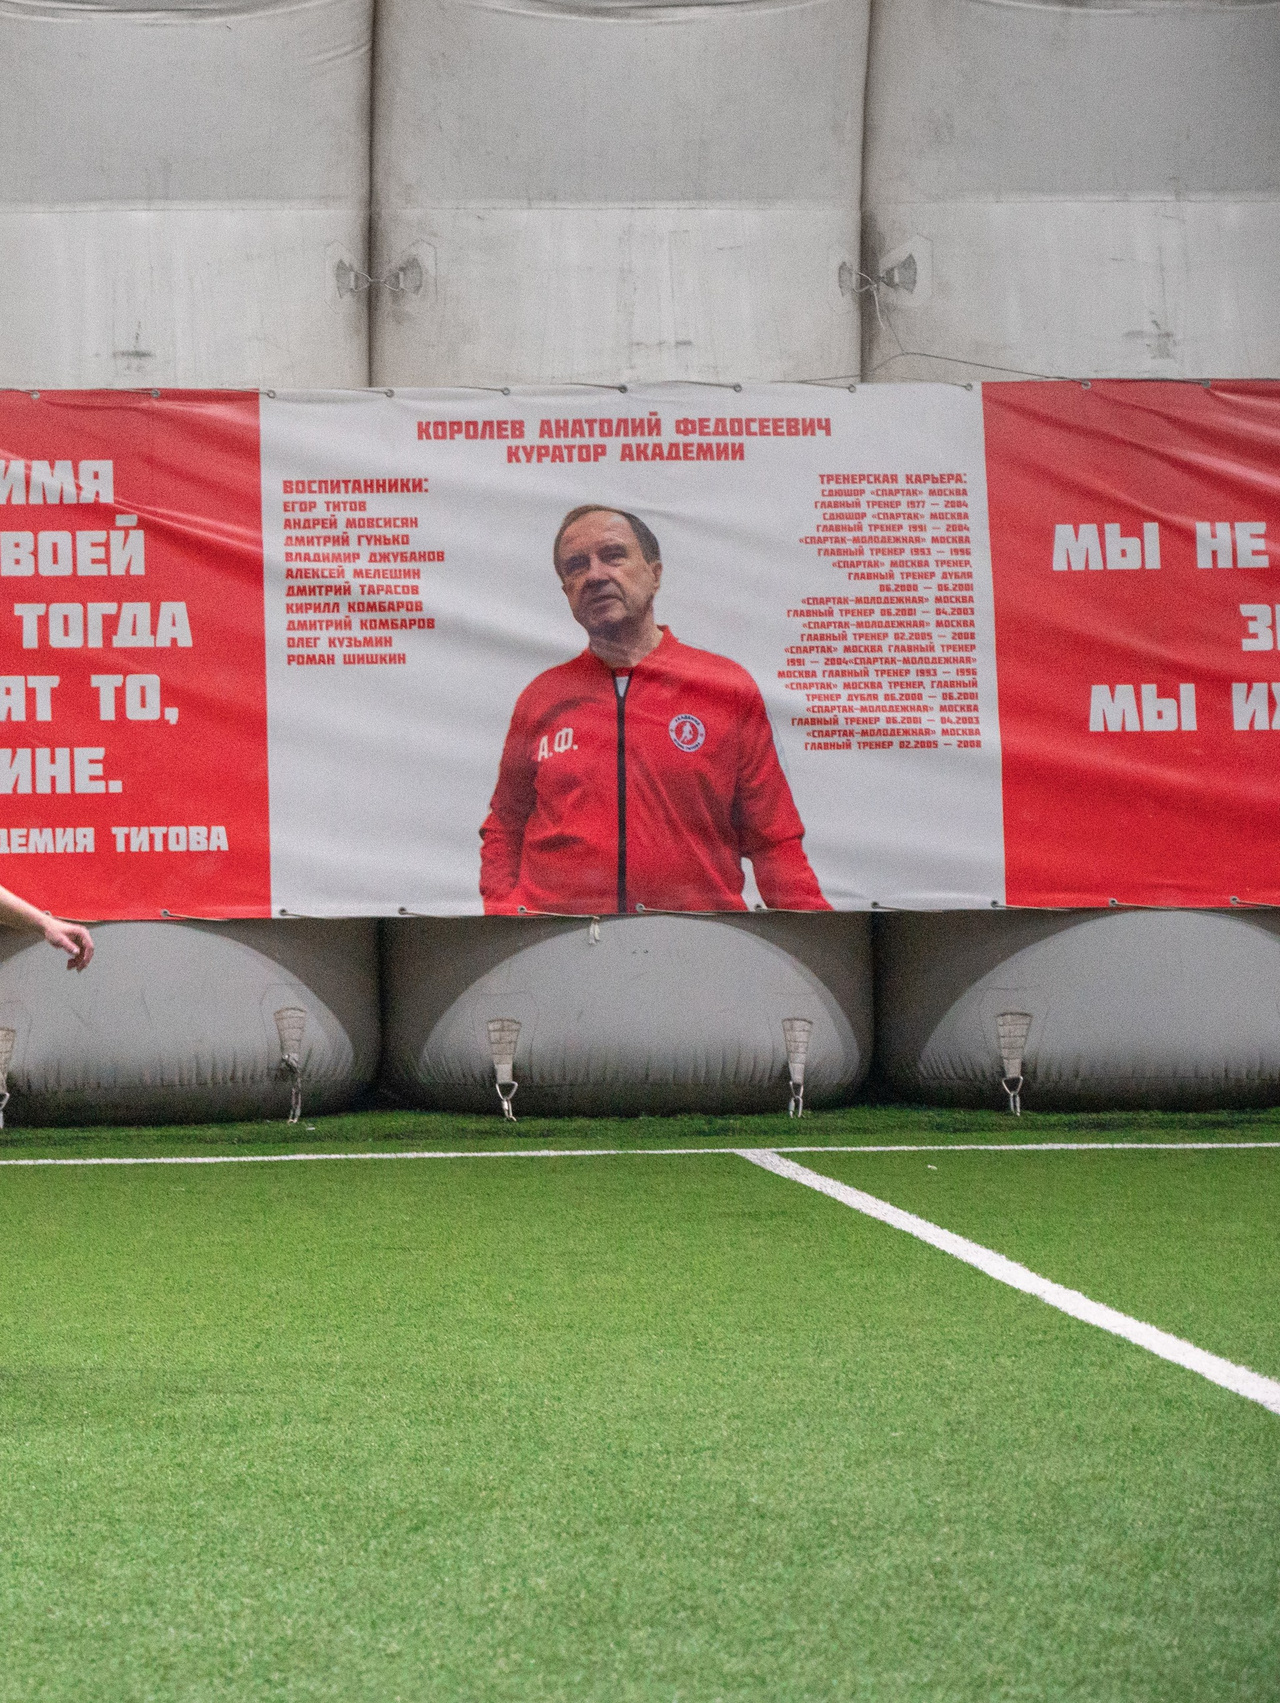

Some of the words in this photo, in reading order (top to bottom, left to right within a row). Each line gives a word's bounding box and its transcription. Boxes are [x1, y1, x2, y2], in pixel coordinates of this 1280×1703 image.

[417, 420, 525, 440] КОРОЛЕВ
[539, 412, 661, 438] АНАТОЛИЙ
[675, 417, 831, 437] ФЕДОСЕЕВИЧ
[507, 443, 607, 463] КУРАТОР
[620, 442, 744, 461] АКАДЕМИИ
[283, 478, 428, 494] ВОСПИТАННИКИ:
[283, 501, 317, 512] ЕГОР
[325, 500, 367, 512] ТИТОВ
[283, 514, 337, 530] АНДРЕЙ
[345, 516, 418, 528] МОВСИСЯН
[284, 531, 350, 546] ДМИТРИЙ
[357, 533, 409, 546] ГУНЬКО
[1052, 522, 1161, 571] МЫ
[1195, 521, 1269, 569] НЕ
[285, 551, 360, 563] ВЛАДИМИР
[368, 550, 445, 562] ДЖУБАНОВ
[285, 565, 345, 579] АЛЕКСЕЙ
[353, 568, 420, 579] МЕЛЕШИН
[285, 581, 351, 597] ДМИТРИЙ
[360, 583, 419, 595] ТАРАСОВ
[286, 601, 340, 613] КИРИЛЛ
[348, 600, 423, 613] КОМБАРОВ
[14, 601, 194, 648] ТОГДА
[287, 615, 352, 630] ДМИТРИЙ
[360, 617, 435, 630] КОМБАРОВ
[287, 636, 320, 648] ОЛЕГ
[328, 635, 392, 648] КУЗЬМИН
[287, 653, 335, 665] РОМАН
[343, 653, 406, 664] ШИШКИН
[90, 673, 180, 725] ТО,
[1089, 683, 1198, 732] МЫ
[111, 825, 229, 852] ТИТОВА
